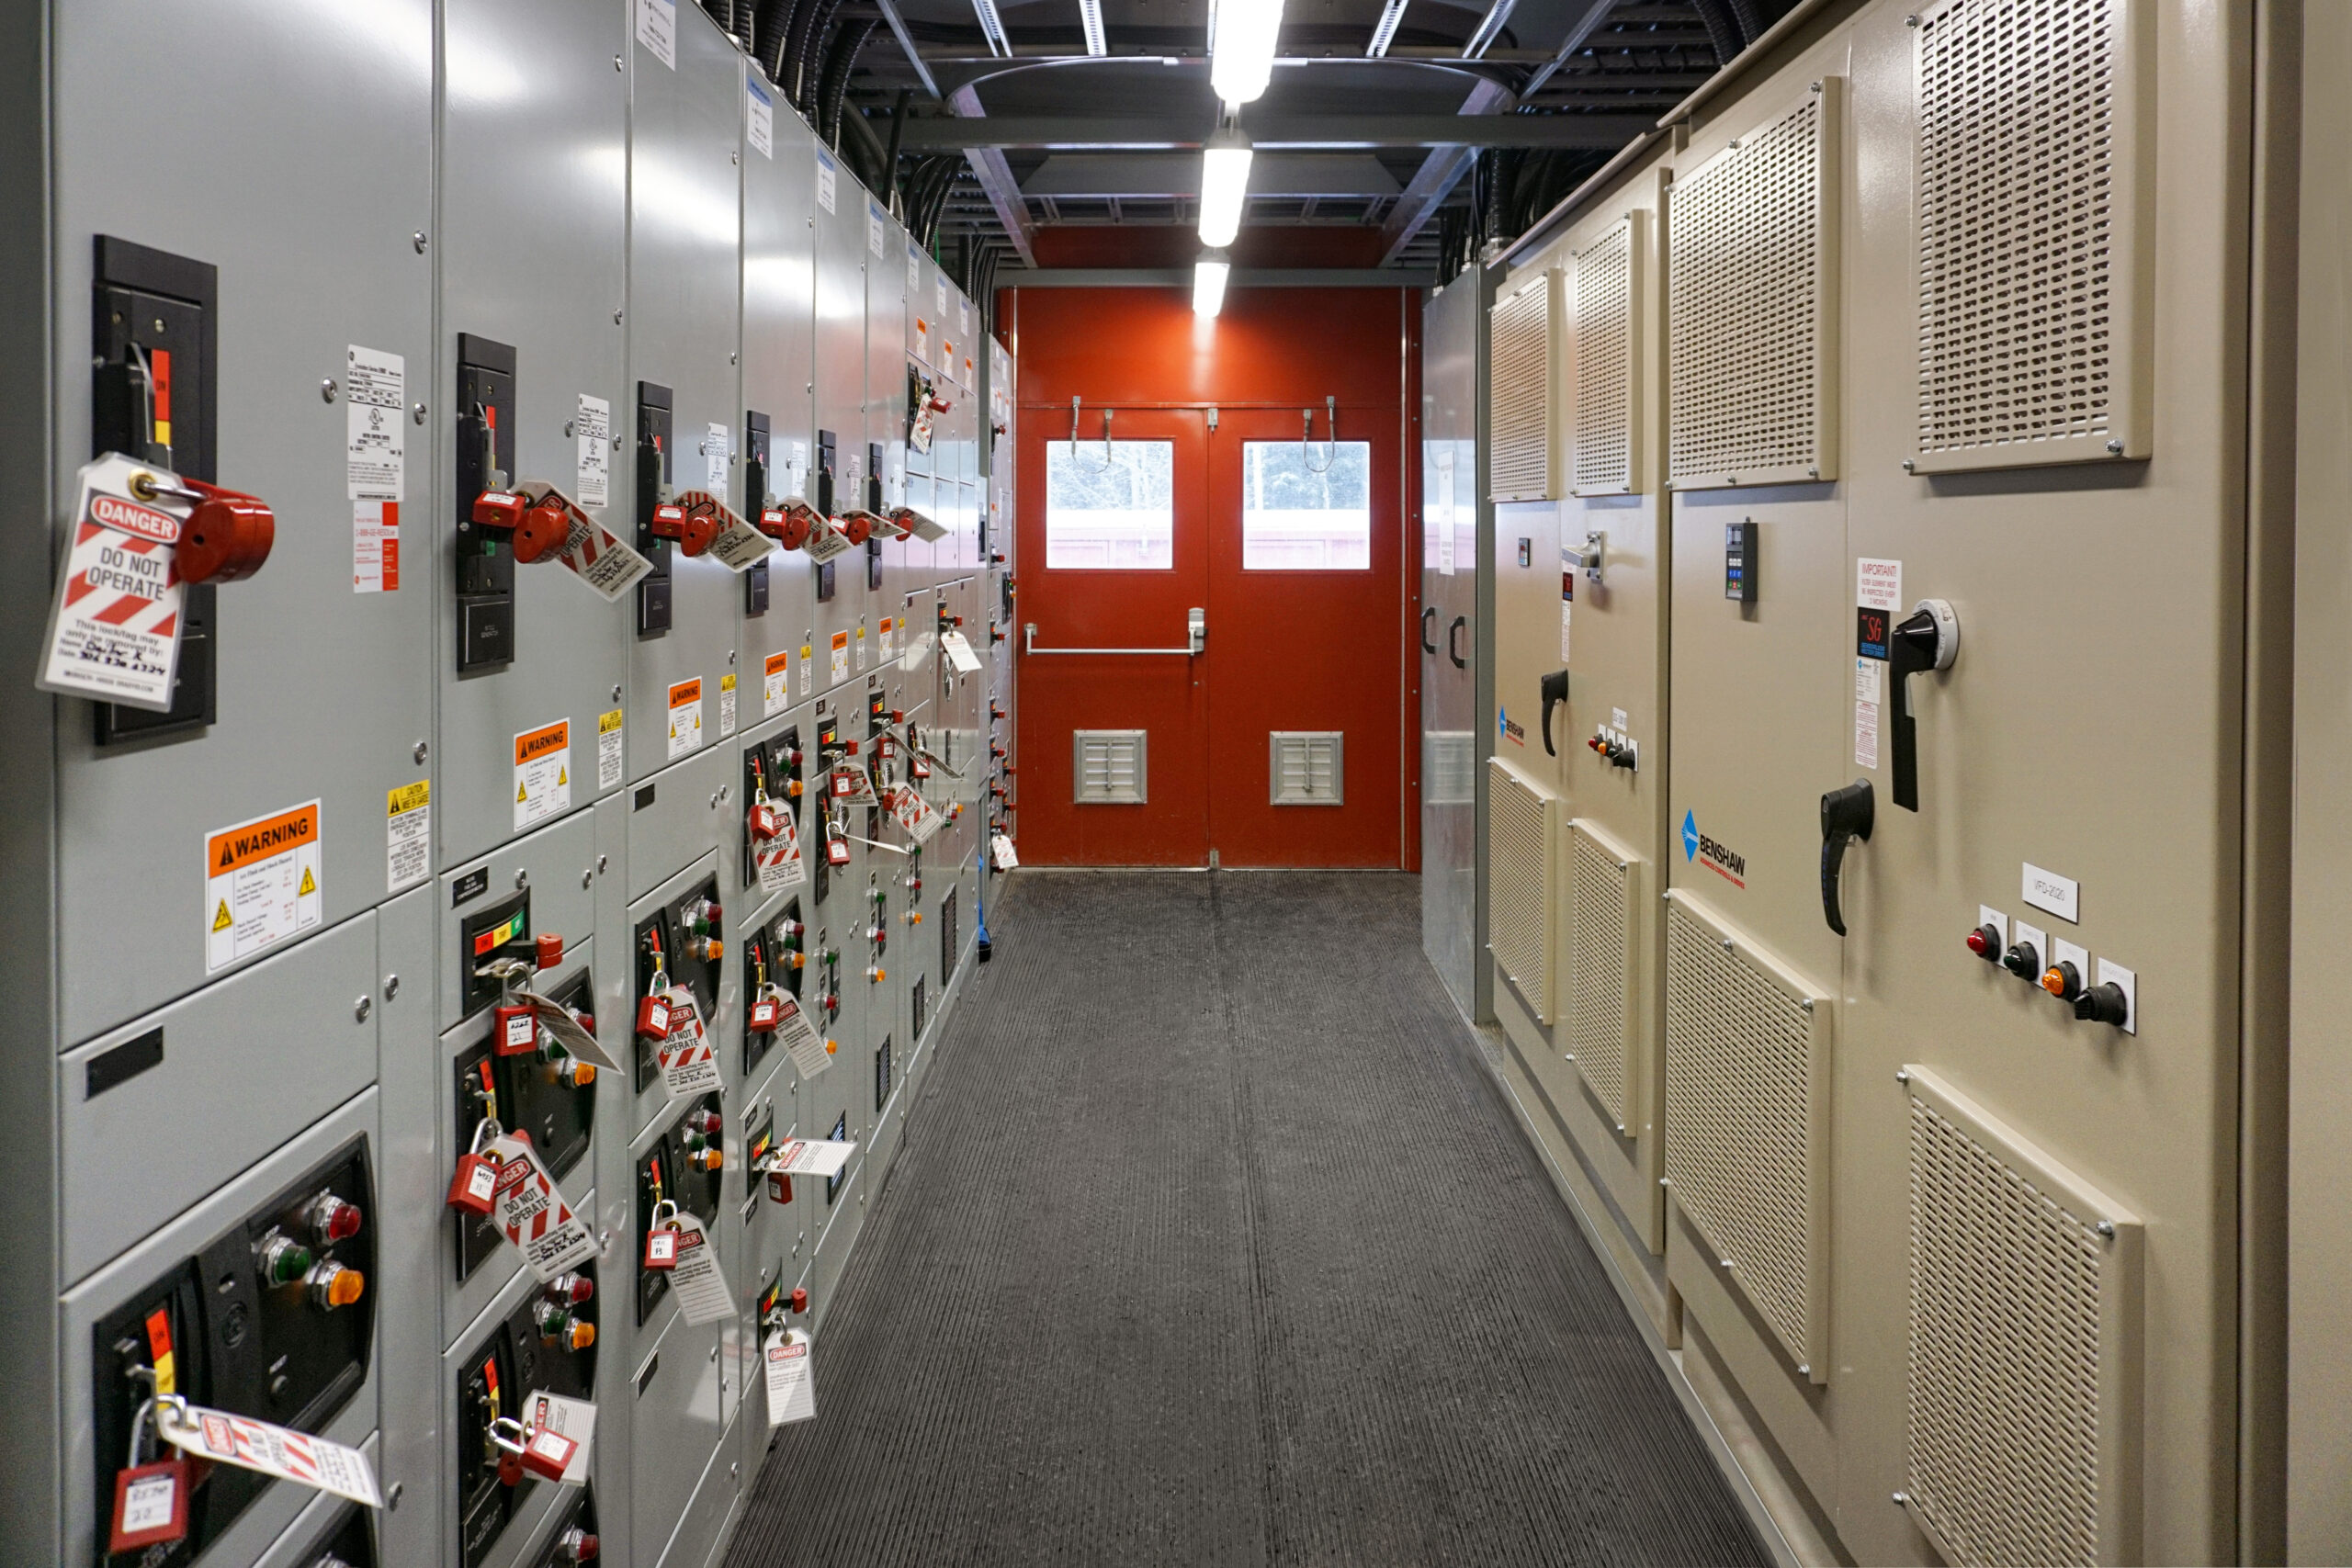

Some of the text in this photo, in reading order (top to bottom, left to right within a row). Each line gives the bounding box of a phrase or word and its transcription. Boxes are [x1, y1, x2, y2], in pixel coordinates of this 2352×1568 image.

[98, 501, 175, 540] DANGER
[560, 525, 594, 556] OPERATE
[101, 547, 162, 579] DO NOT
[1861, 562, 1896, 577] IMPORTANT!
[89, 567, 164, 601] OPERATE
[65, 629, 87, 641] only
[76, 619, 96, 631] This
[140, 636, 159, 646] may
[1867, 617, 1882, 641] SG
[677, 685, 698, 700] WARNING
[1507, 718, 1524, 739] BENSHAW
[527, 730, 563, 754] WARNING
[234, 818, 309, 858] WARNING
[762, 840, 791, 855] OPERATE
[1700, 833, 1746, 876] BENSHAW
[663, 1038, 699, 1054] OPERATE
[676, 1029, 693, 1040] NOT
[497, 1161, 527, 1187] NGER
[503, 1187, 538, 1213] DO NOT
[508, 1196, 550, 1226] OPERATE
[773, 1347, 802, 1359] DANGER
